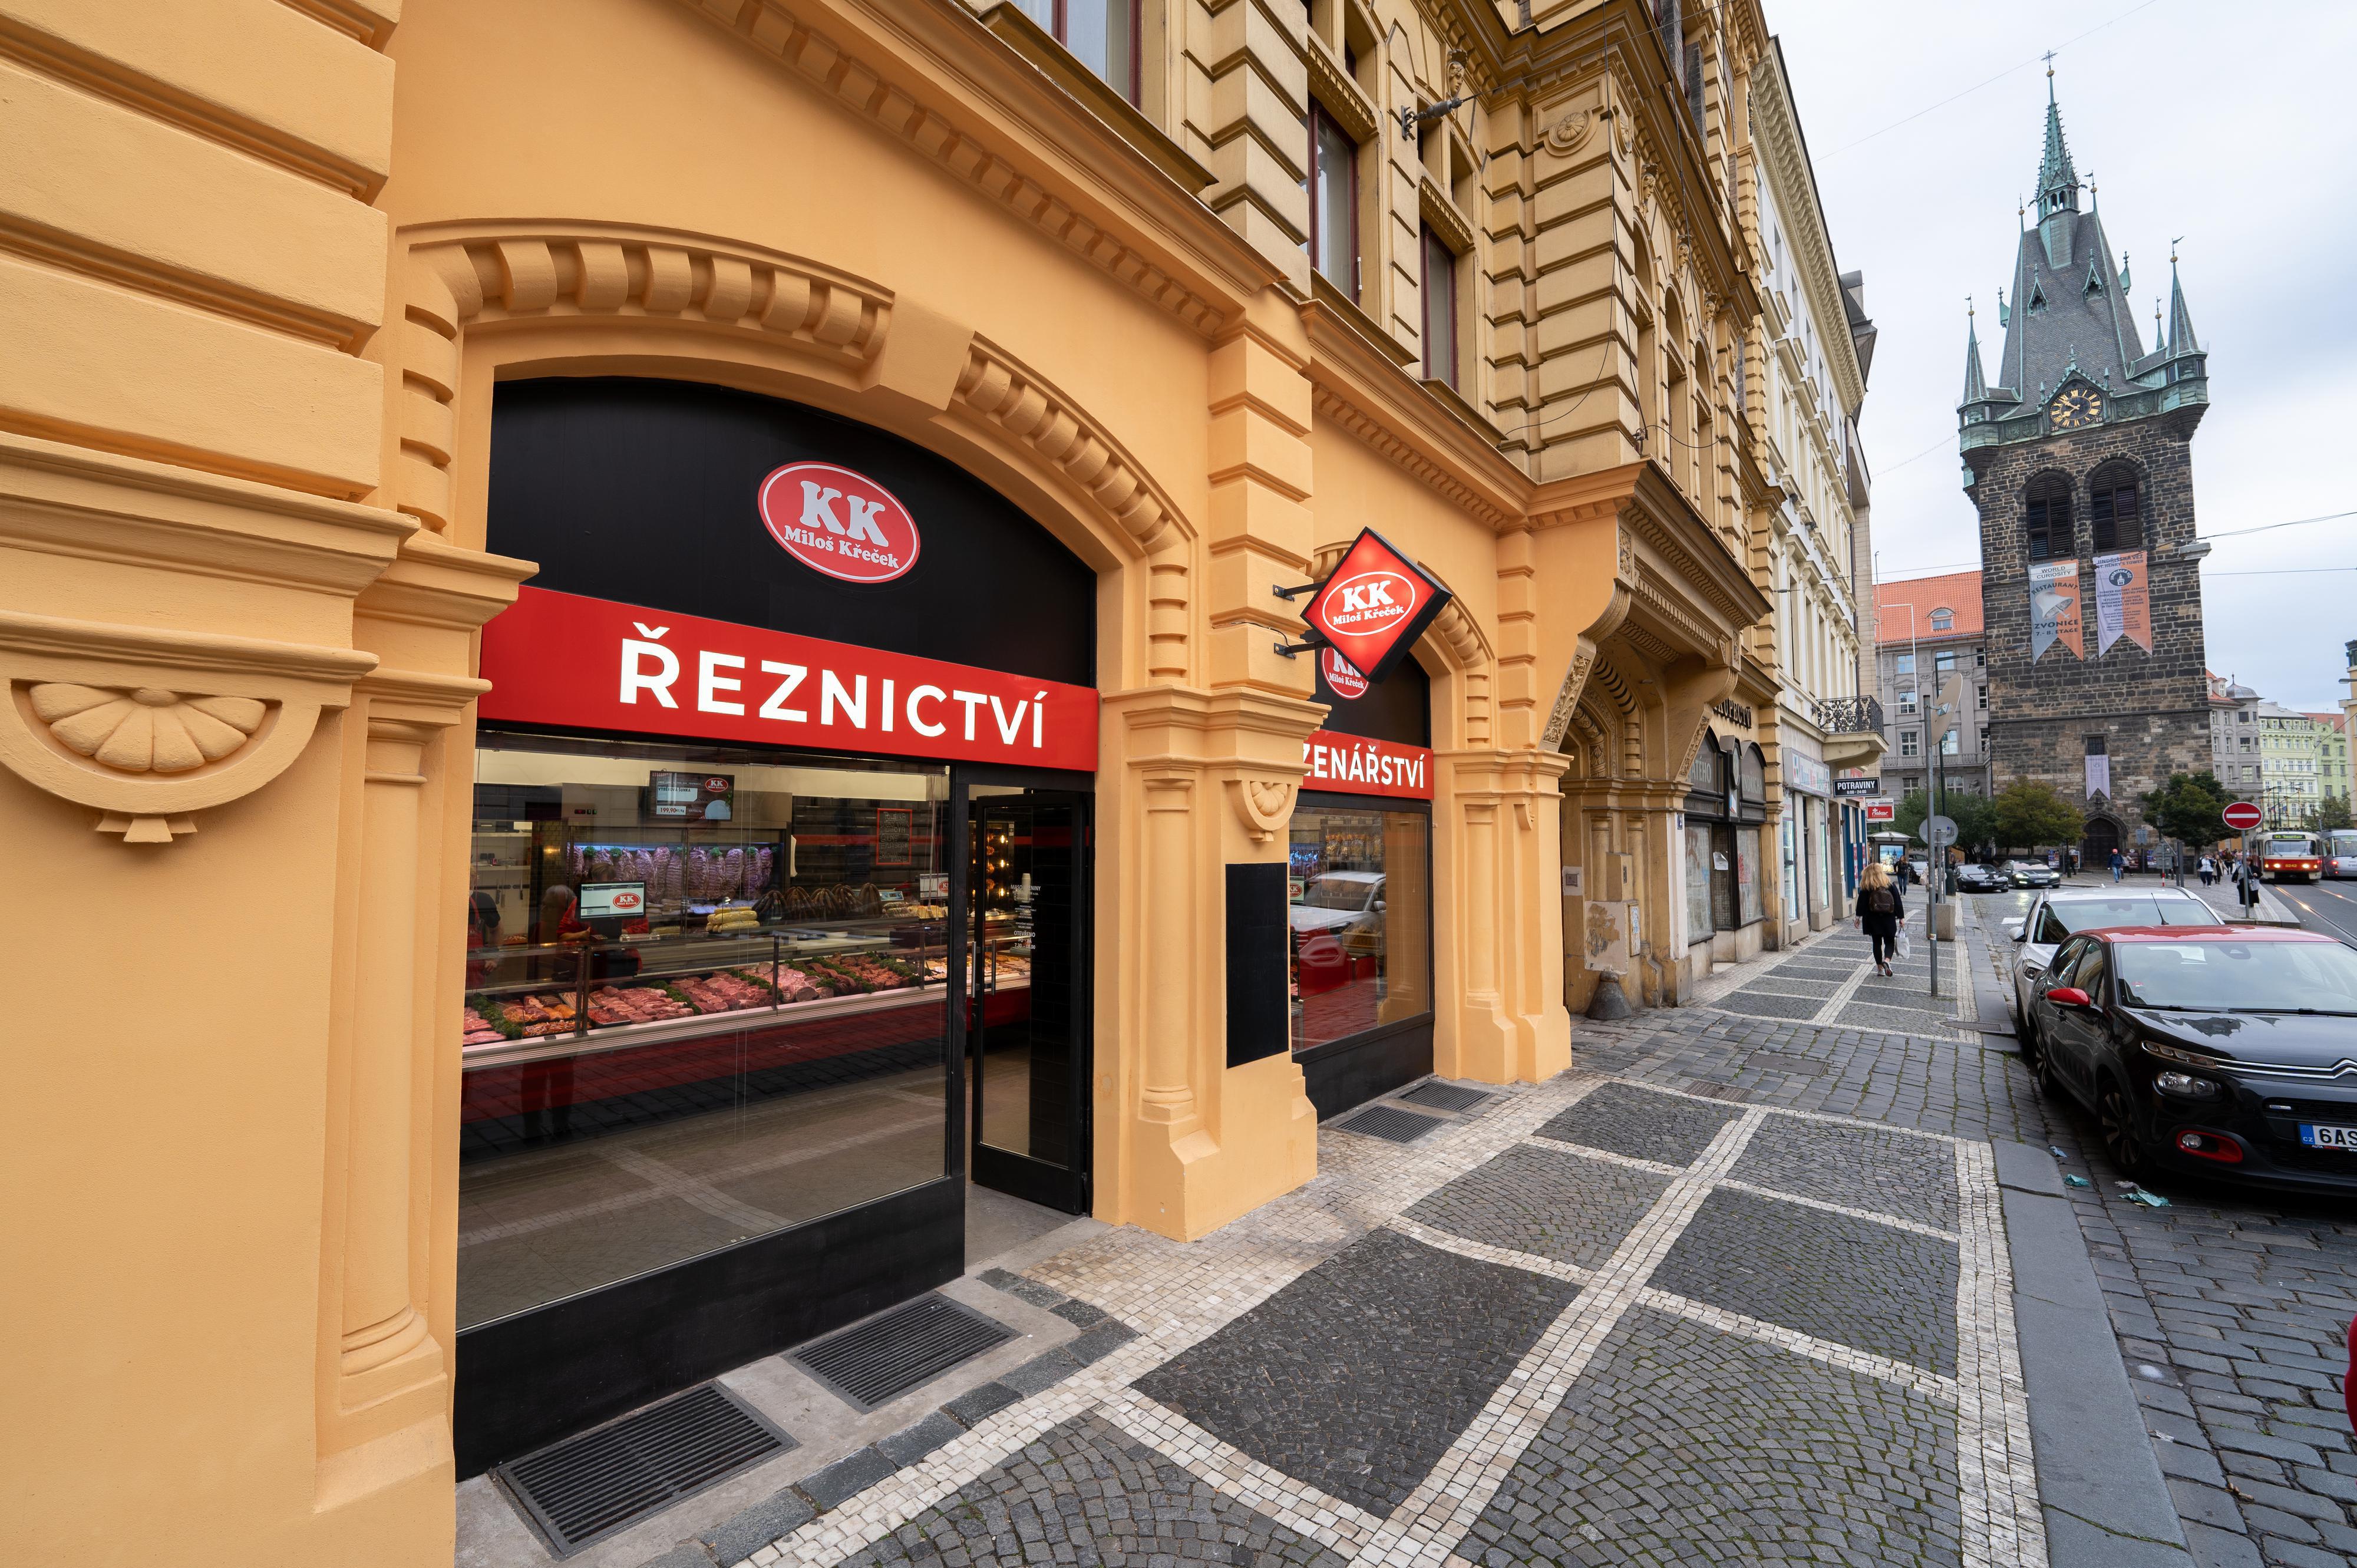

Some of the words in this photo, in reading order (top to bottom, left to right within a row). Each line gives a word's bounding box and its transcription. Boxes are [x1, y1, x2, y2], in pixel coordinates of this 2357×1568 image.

[800, 480, 890, 547] KK
[784, 525, 834, 554] Miloš
[838, 540, 900, 569] Křeček
[2036, 570, 2071, 579] CURIOSITY
[1342, 580, 1394, 612] KK
[2031, 582, 2078, 595] RESTAURANT
[1333, 610, 1361, 625] Miloš
[1364, 605, 1404, 620] Křeček
[2034, 619, 2079, 629] ZVONICE
[620, 621, 1047, 748] ŘEZNICTVÍ
[1329, 673, 1344, 684] Miloš
[1345, 676, 1365, 689] Křeček
[1690, 755, 1712, 784] ATÉHO
[1837, 781, 1875, 790] POTRAVINY
[2319, 1128, 2357, 1146] 6AS
